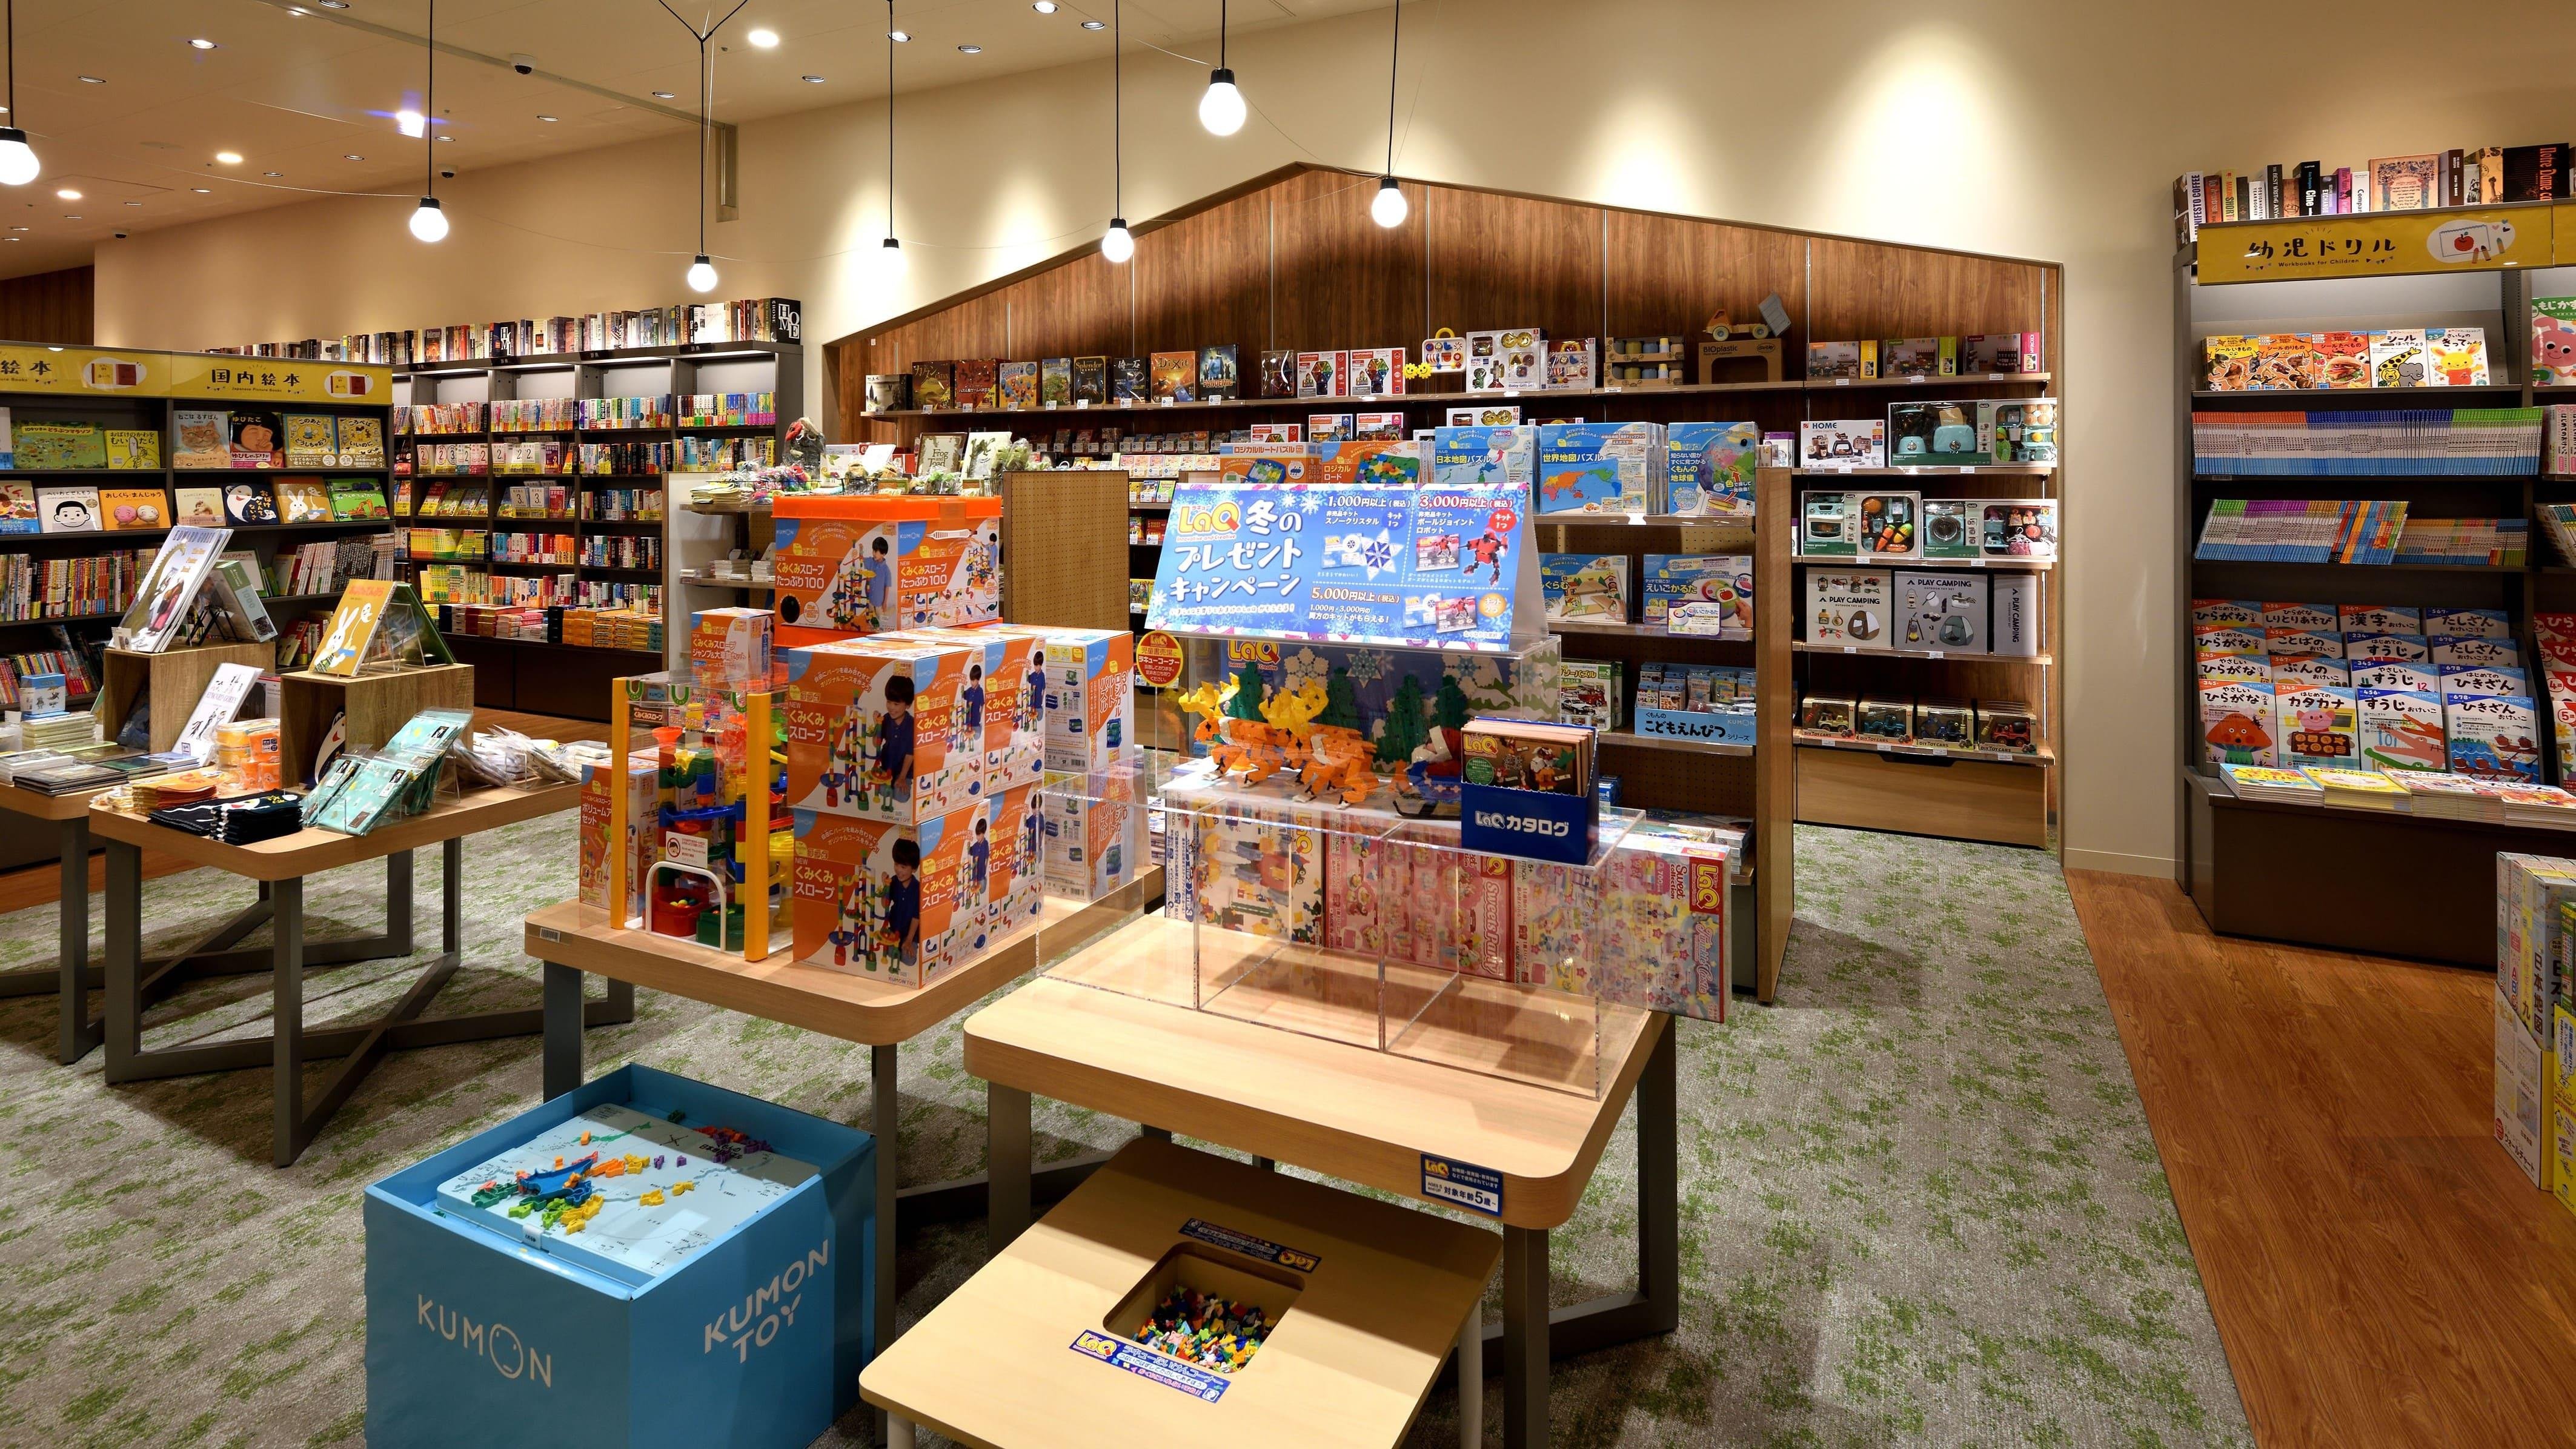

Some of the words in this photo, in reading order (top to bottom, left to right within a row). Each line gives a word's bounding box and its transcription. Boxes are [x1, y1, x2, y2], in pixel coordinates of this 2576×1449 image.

[2539, 147, 2557, 168] Notre
[2540, 169, 2555, 190] Dame
[2306, 190, 2316, 207] Cine
[2248, 238, 2395, 259] 幼児ドリル
[212, 369, 301, 386] 国内絵本
[932, 449, 948, 459] Frog
[1436, 454, 1492, 465] 日本地図パズル
[1543, 453, 1604, 463] 世界地図パズル
[1328, 496, 1387, 508] 1,000円以上
[1419, 495, 1489, 508] 3,000円以上
[1178, 502, 1240, 533] LaQ
[1245, 499, 1302, 536] 冬の
[1174, 537, 1302, 572] プレゼント
[776, 563, 825, 575] くみくみスロープ
[900, 563, 947, 575] くみくみスロープ
[1170, 574, 1301, 603] キャンペーン
[1311, 587, 1375, 602] 5,000円以上
[1645, 583, 1697, 594] えいごかるた
[1846, 596, 1880, 605] CAMPING
[2196, 611, 2248, 621] ひらがな
[2266, 615, 2332, 625] しりとりあそび
[2350, 613, 2388, 626] 漢字
[2442, 615, 2494, 627] たしざん
[2198, 637, 2251, 648] ひらがな
[2278, 637, 2325, 646] ことばの
[2449, 643, 2503, 655] たしざん
[1228, 639, 1281, 664] LaQ
[2367, 645, 2408, 657] すうじ
[1138, 656, 1180, 665] ラキューコーナー
[2284, 663, 2328, 674] ぶんの
[2201, 664, 2256, 675] ひらがな
[2372, 673, 2414, 686] すうじ
[2454, 678, 2515, 691] ひきざん
[986, 695, 1014, 711] くみくみ
[2205, 692, 2260, 705] ひらがな
[2288, 697, 2345, 709] カタカナ
[2365, 698, 2406, 712] すうじ
[986, 708, 1016, 723] スロープ
[2461, 701, 2516, 714] ひきざん
[789, 710, 825, 726] くみくみ
[917, 713, 948, 731] くみくみ
[1727, 718, 1755, 727] KUMON
[789, 726, 826, 742] スロープ
[917, 726, 950, 745] スロープ
[1645, 720, 1726, 738] こどもえんぴつ
[1463, 734, 1498, 755] LaQ
[582, 815, 597, 824] セット
[1507, 815, 1570, 837] カタログ
[795, 857, 808, 866] NEW
[795, 866, 834, 884] くみくみ
[1676, 866, 1688, 900] Sweet
[795, 881, 835, 900] スロープ
[922, 874, 954, 894] くみくみ
[1697, 863, 1719, 909] LaQ
[922, 889, 958, 909] スロープ
[1483, 880, 1501, 932] Sweets
[2534, 952, 2543, 1036] 日本地図
[1425, 1159, 1449, 1176] LaQ
[704, 1239, 829, 1354] KUMON
[732, 1293, 803, 1364] TOY
[418, 1293, 553, 1388] KUMON
[1077, 1333, 1117, 1357] LaQ
[1123, 1345, 1224, 1385] ラキューたいけんコーナー
